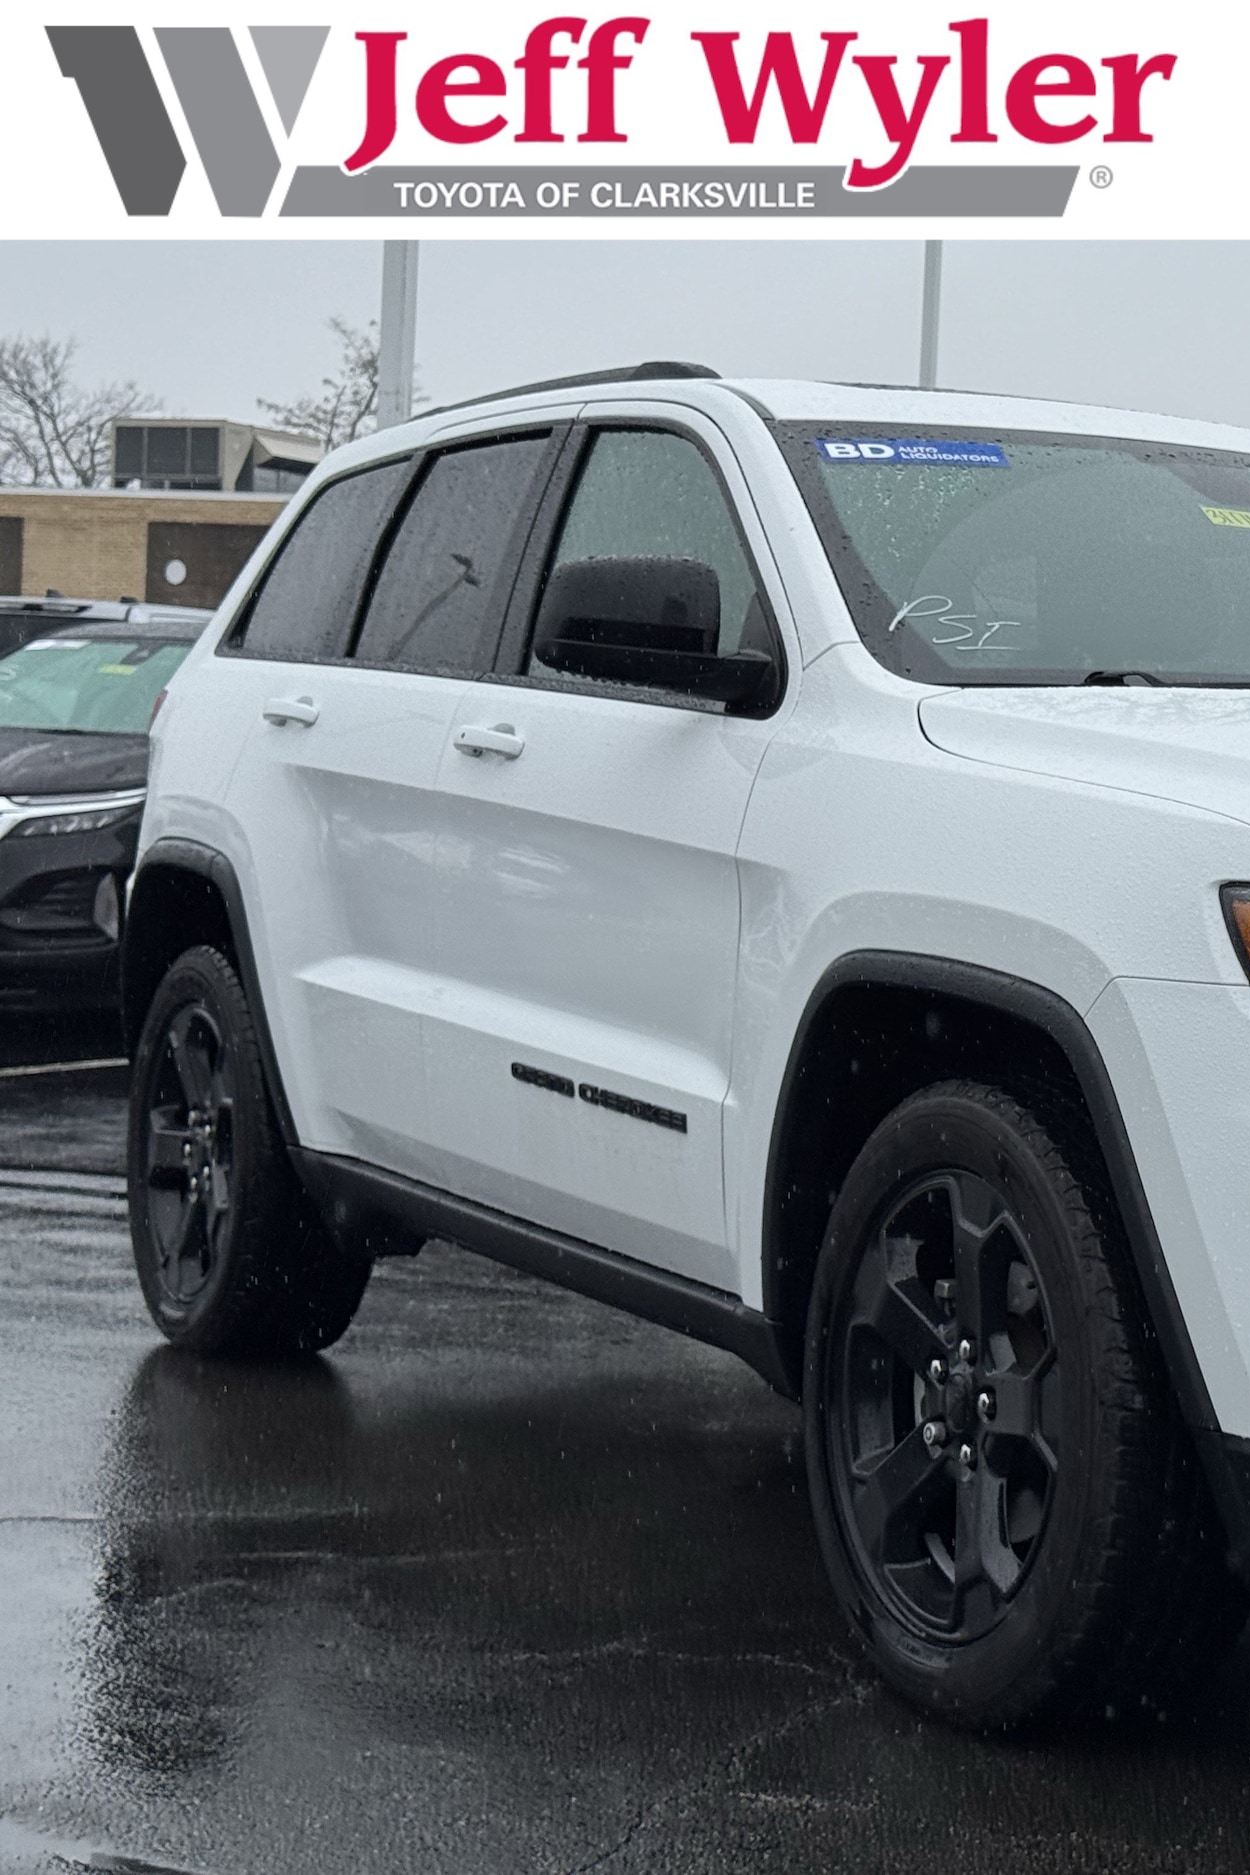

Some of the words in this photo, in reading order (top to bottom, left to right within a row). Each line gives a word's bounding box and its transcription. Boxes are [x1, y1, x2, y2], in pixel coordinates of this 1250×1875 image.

[823, 442, 896, 459] BD
[898, 446, 938, 454] AUTO
[900, 452, 1000, 464] LIQUIDATORS
